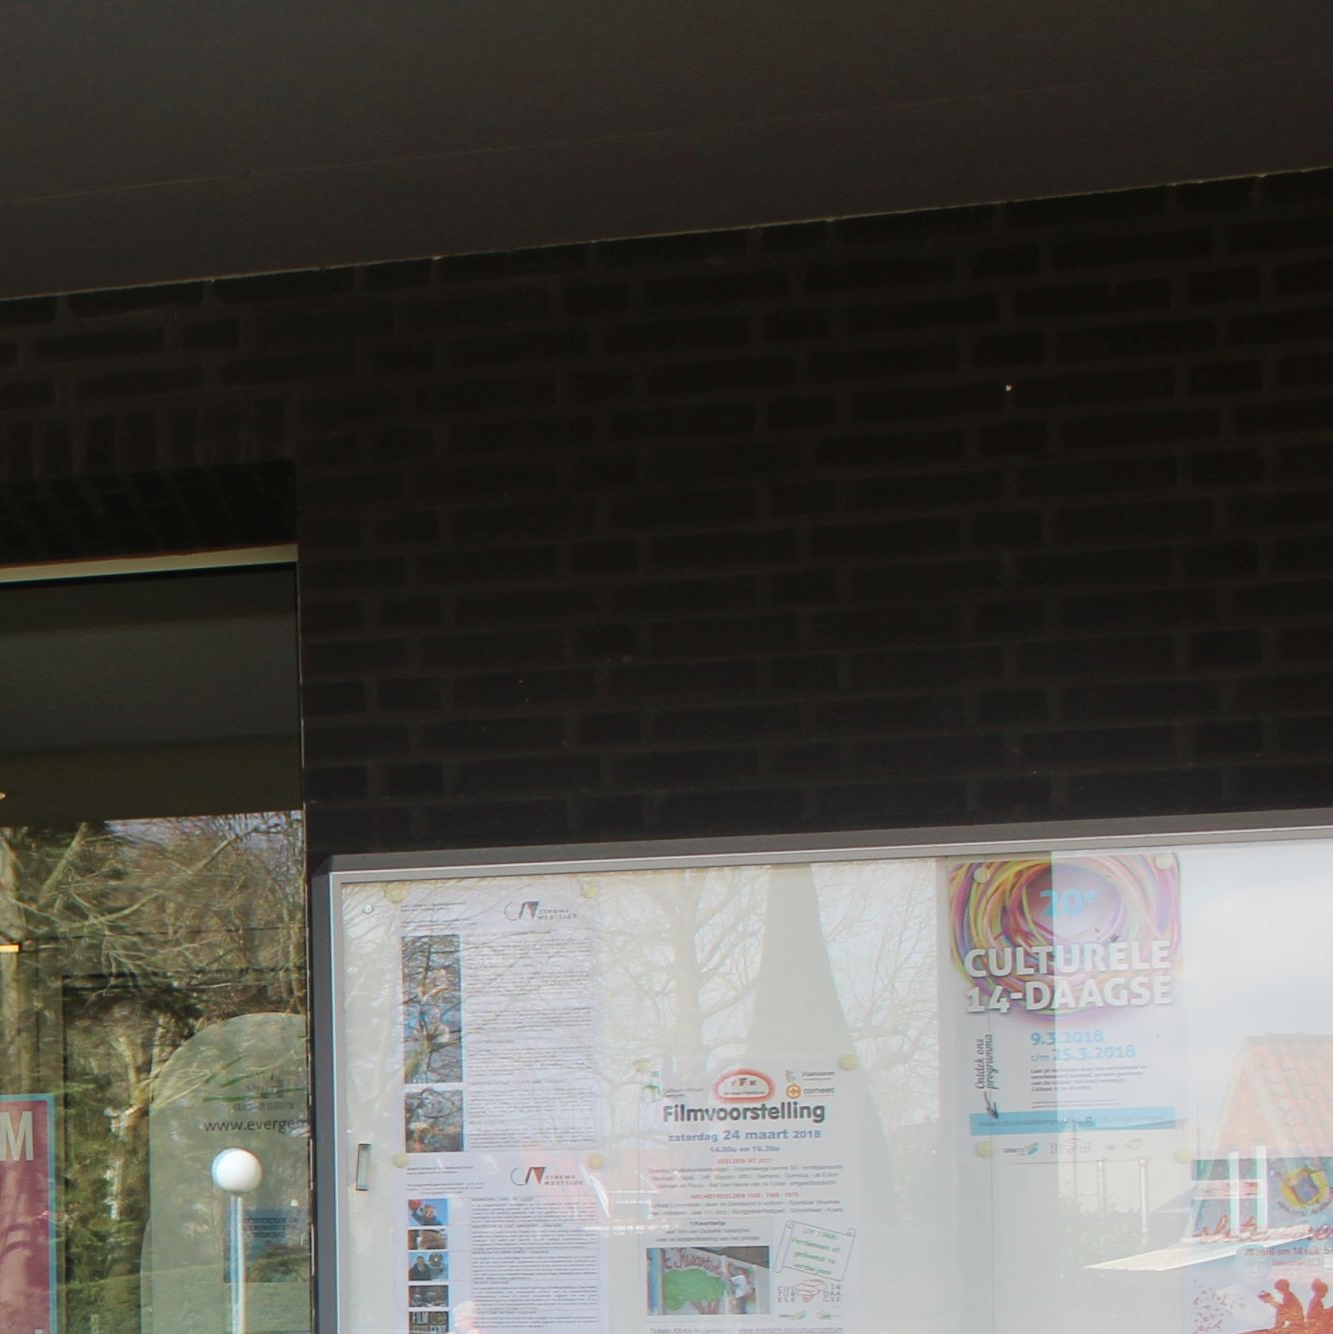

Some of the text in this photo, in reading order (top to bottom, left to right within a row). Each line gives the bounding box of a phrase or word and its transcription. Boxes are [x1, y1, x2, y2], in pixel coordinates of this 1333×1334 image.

[963, 940, 1172, 978] CULTURELE
[965, 975, 1173, 1014] 14-DAAGSE
[1030, 1029, 1104, 1046] 9.3.2018
[662, 1102, 826, 1124] Filmvoorstelling
[667, 1129, 821, 1143] zaterdag 24 maart 2018
